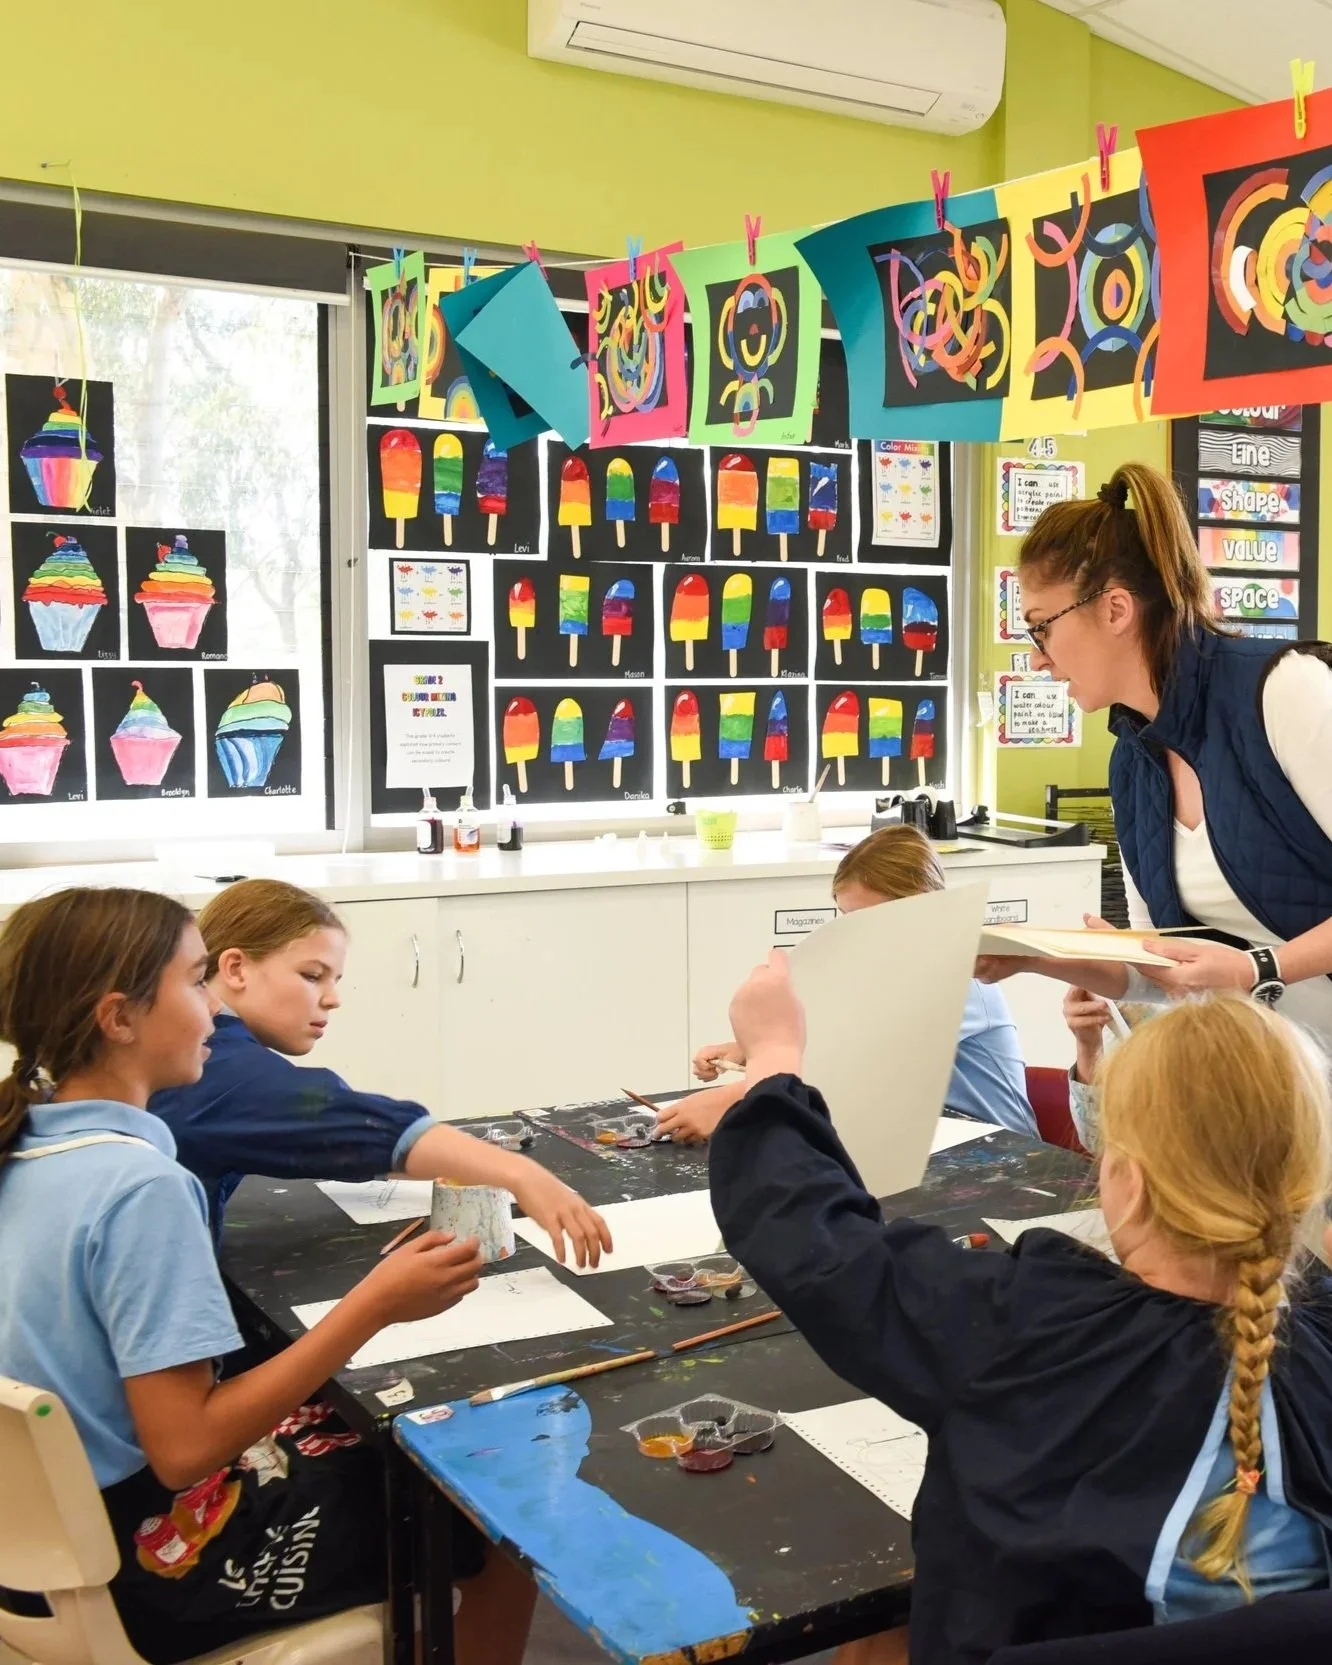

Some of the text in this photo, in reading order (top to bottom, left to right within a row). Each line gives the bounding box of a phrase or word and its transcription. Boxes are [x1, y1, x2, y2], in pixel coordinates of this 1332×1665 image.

[880, 441, 902, 451] Color
[1231, 443, 1271, 467] Line
[1024, 480, 1039, 488] can
[1221, 489, 1280, 513] Shape
[514, 542, 530, 553] Levi
[68, 789, 84, 800] Levi
[264, 784, 297, 795] Charlotte
